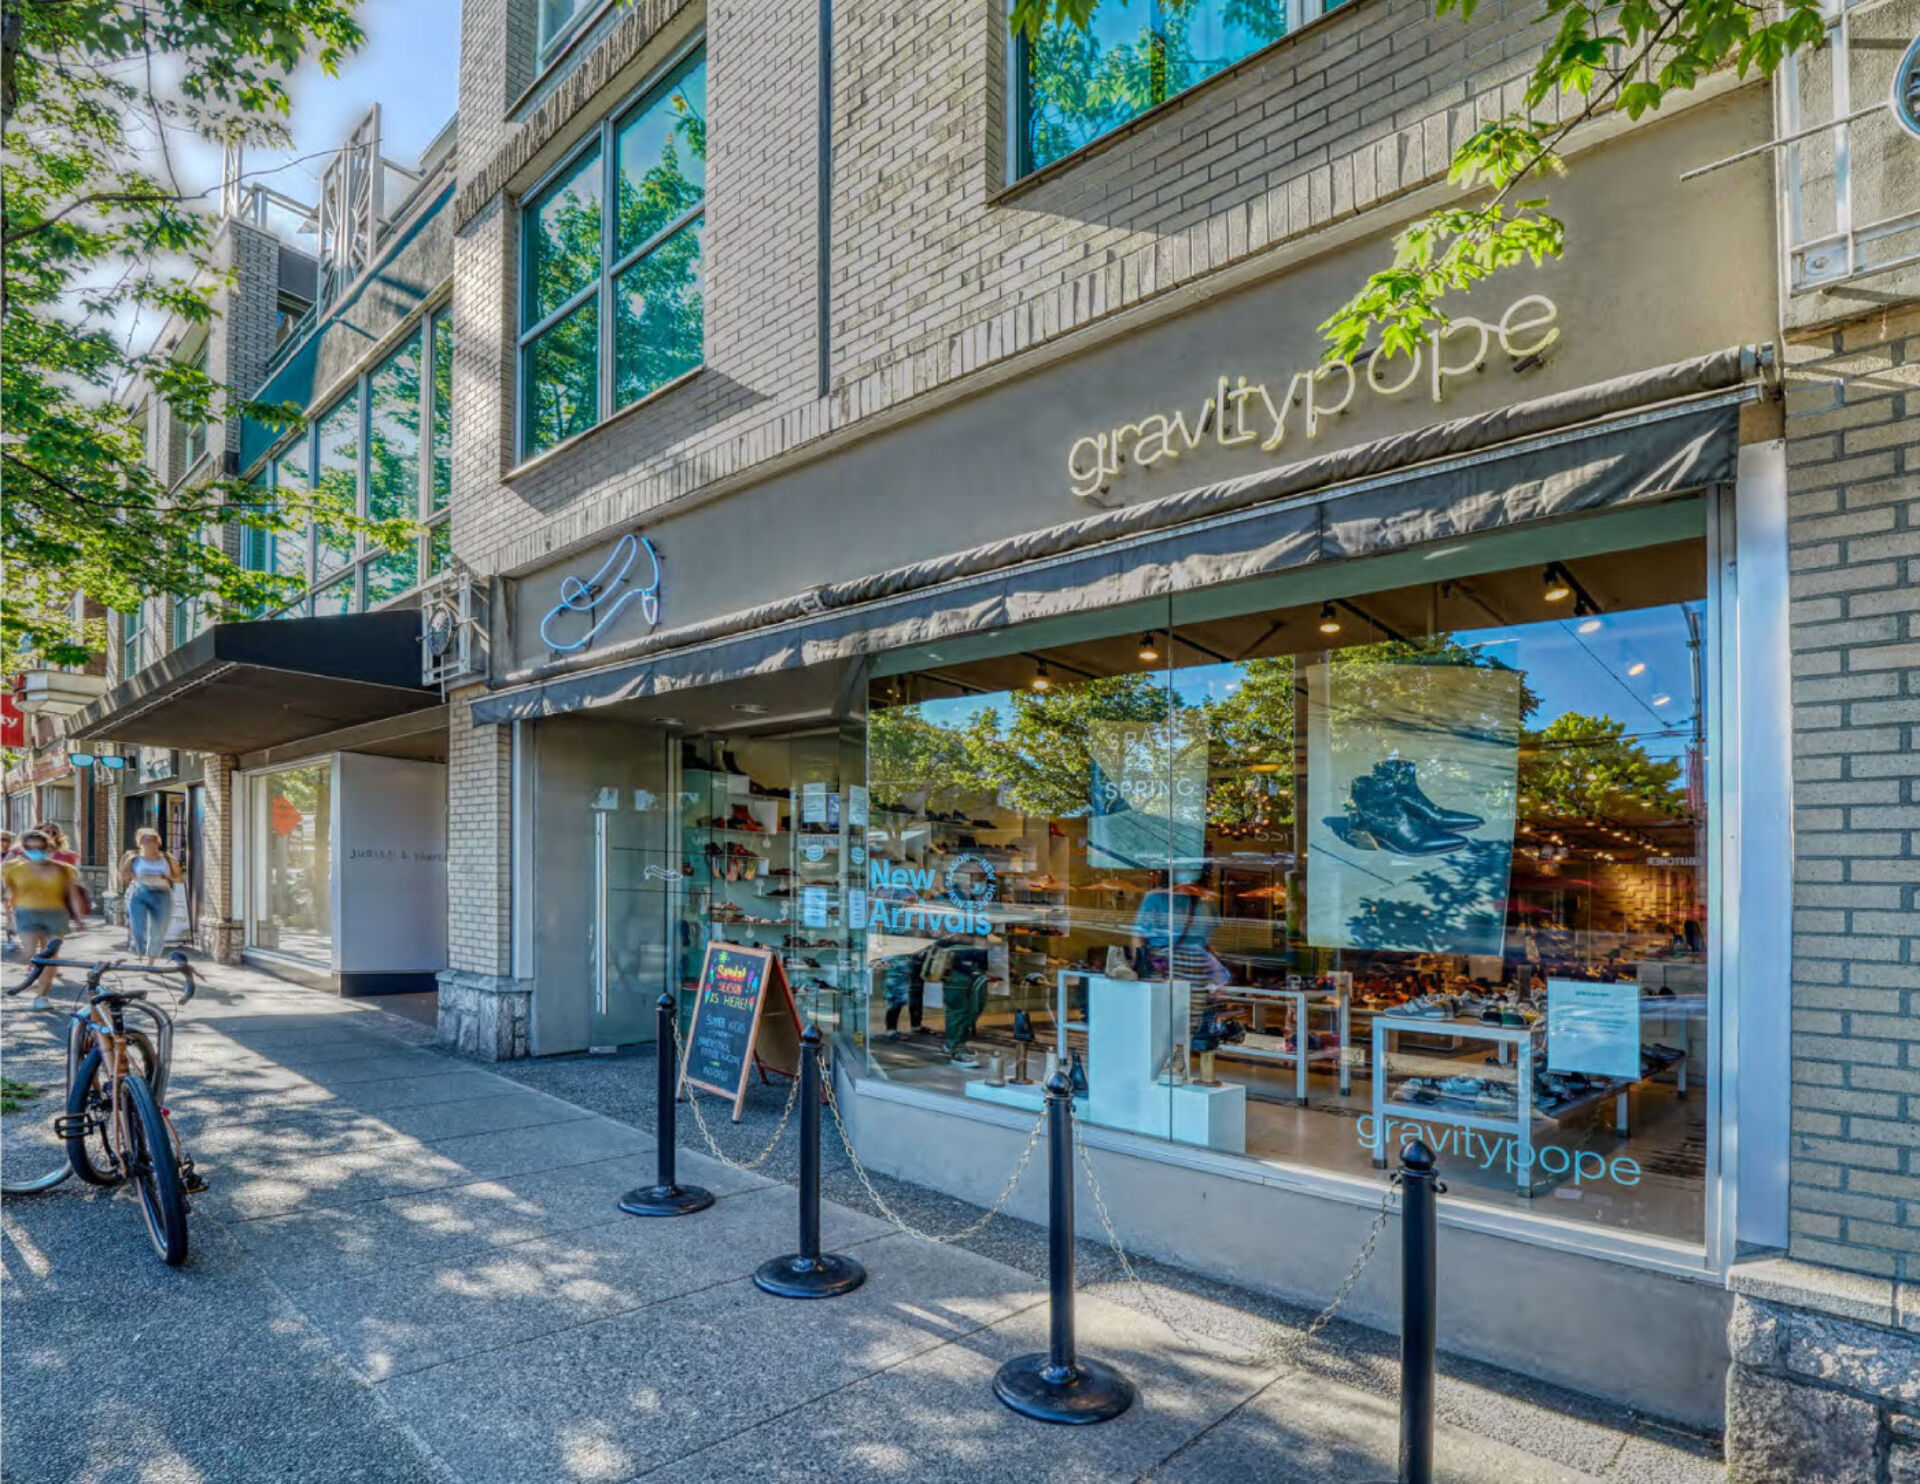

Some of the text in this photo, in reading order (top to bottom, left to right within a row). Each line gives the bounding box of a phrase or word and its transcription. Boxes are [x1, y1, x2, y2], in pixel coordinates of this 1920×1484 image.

[1069, 295, 1558, 497] gravitypope
[1105, 777, 1194, 800] SPRING
[871, 858, 936, 890] New
[980, 857, 997, 881] NEW
[869, 898, 991, 935] Arrivals
[1356, 1104, 1641, 1186] gravitypope
